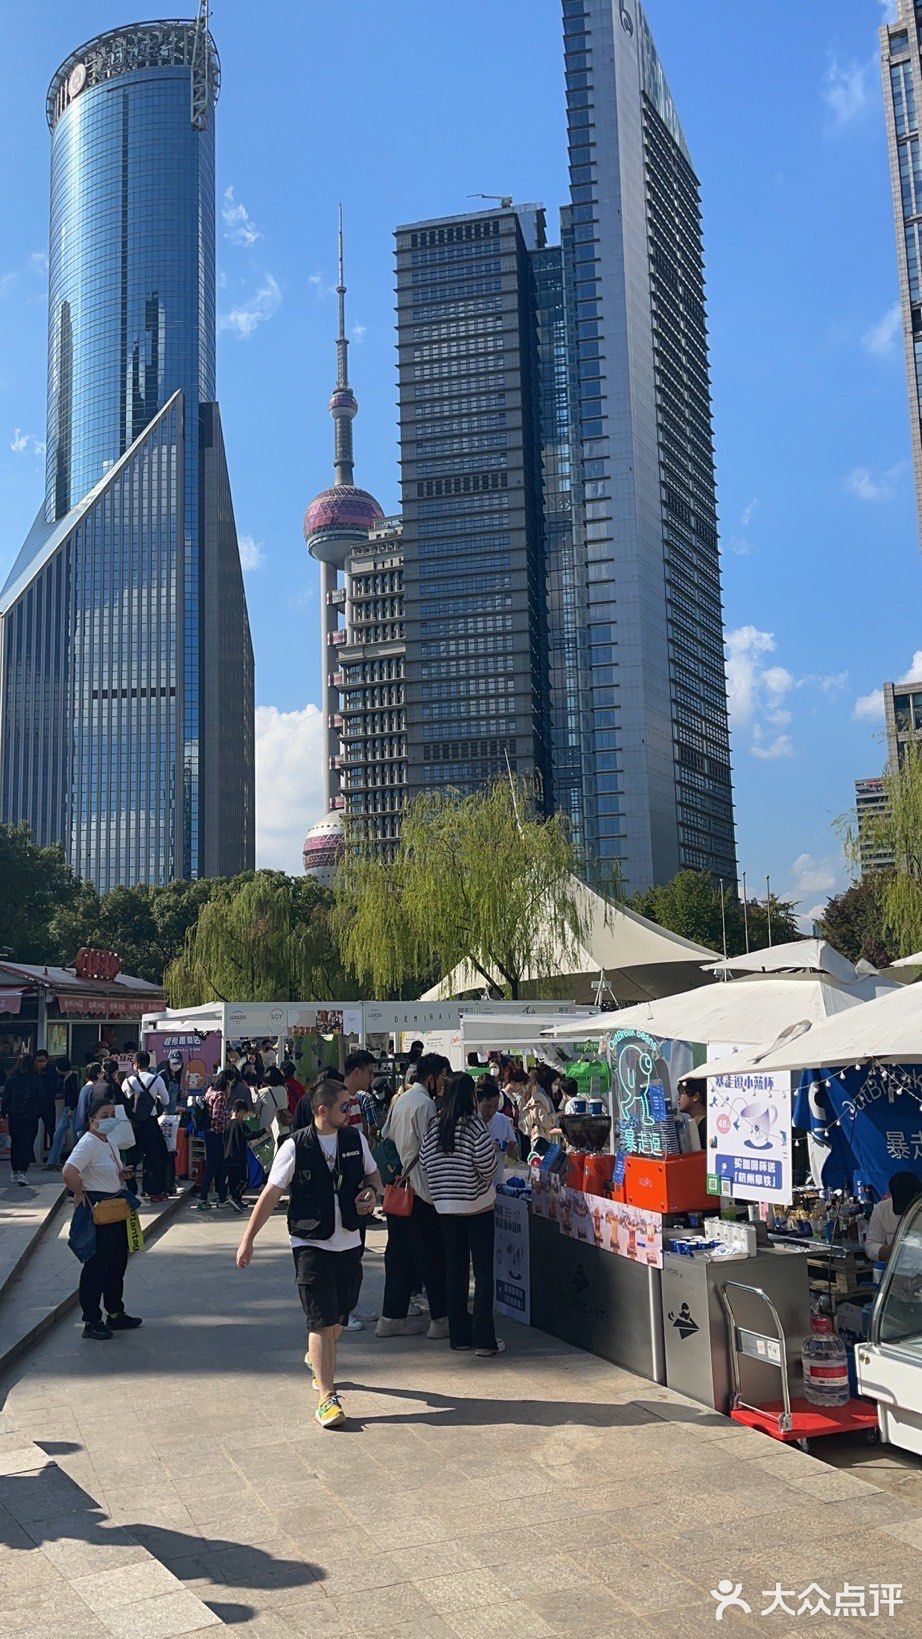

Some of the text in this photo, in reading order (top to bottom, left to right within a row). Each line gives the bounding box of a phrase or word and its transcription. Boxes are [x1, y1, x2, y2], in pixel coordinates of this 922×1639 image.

[734, 1158, 776, 1173] 买咖啡杯送
